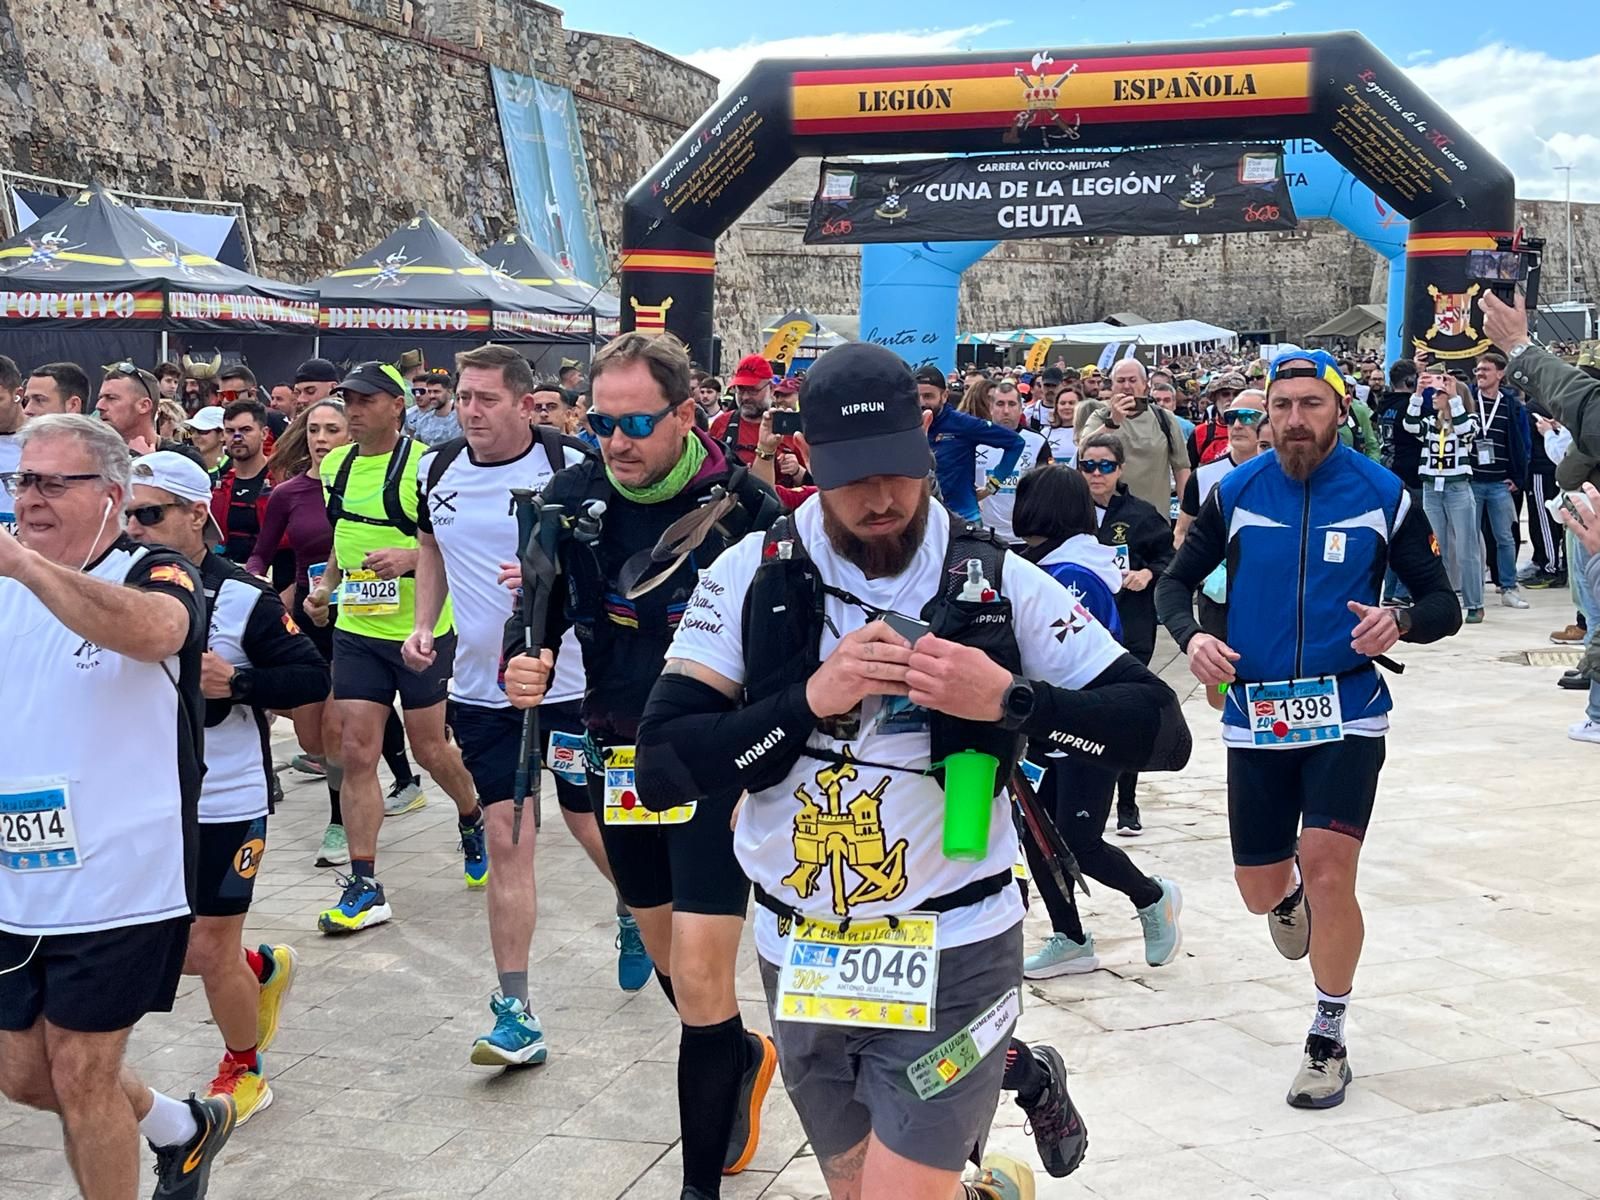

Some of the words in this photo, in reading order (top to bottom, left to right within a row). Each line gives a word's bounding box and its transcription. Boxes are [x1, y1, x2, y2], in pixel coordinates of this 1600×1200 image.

[858, 84, 953, 112] LEGIÓN
[1113, 72, 1257, 101] ESPAÑOLA
[977, 162, 1025, 172] CARRERA
[1028, 158, 1110, 171] CÍVICO-MILITAR
[912, 182, 992, 201] “CUNA
[1000, 181, 1028, 198] DE
[1035, 180, 1064, 197] LA
[1072, 171, 1177, 196] LEGIÓN”
[997, 204, 1084, 228] CEUTA
[328, 307, 469, 330] DEPORTIVO
[841, 401, 885, 416] KIPRUN
[361, 582, 396, 598] 4028
[76, 660, 101, 670] CEUTA
[1279, 696, 1332, 721] 1398
[735, 726, 785, 769] KIPRUN
[1048, 730, 1105, 756] KIPRUN
[3, 810, 65, 841] 2614
[839, 948, 928, 988] 5046
[836, 983, 864, 992] ANTONIO
